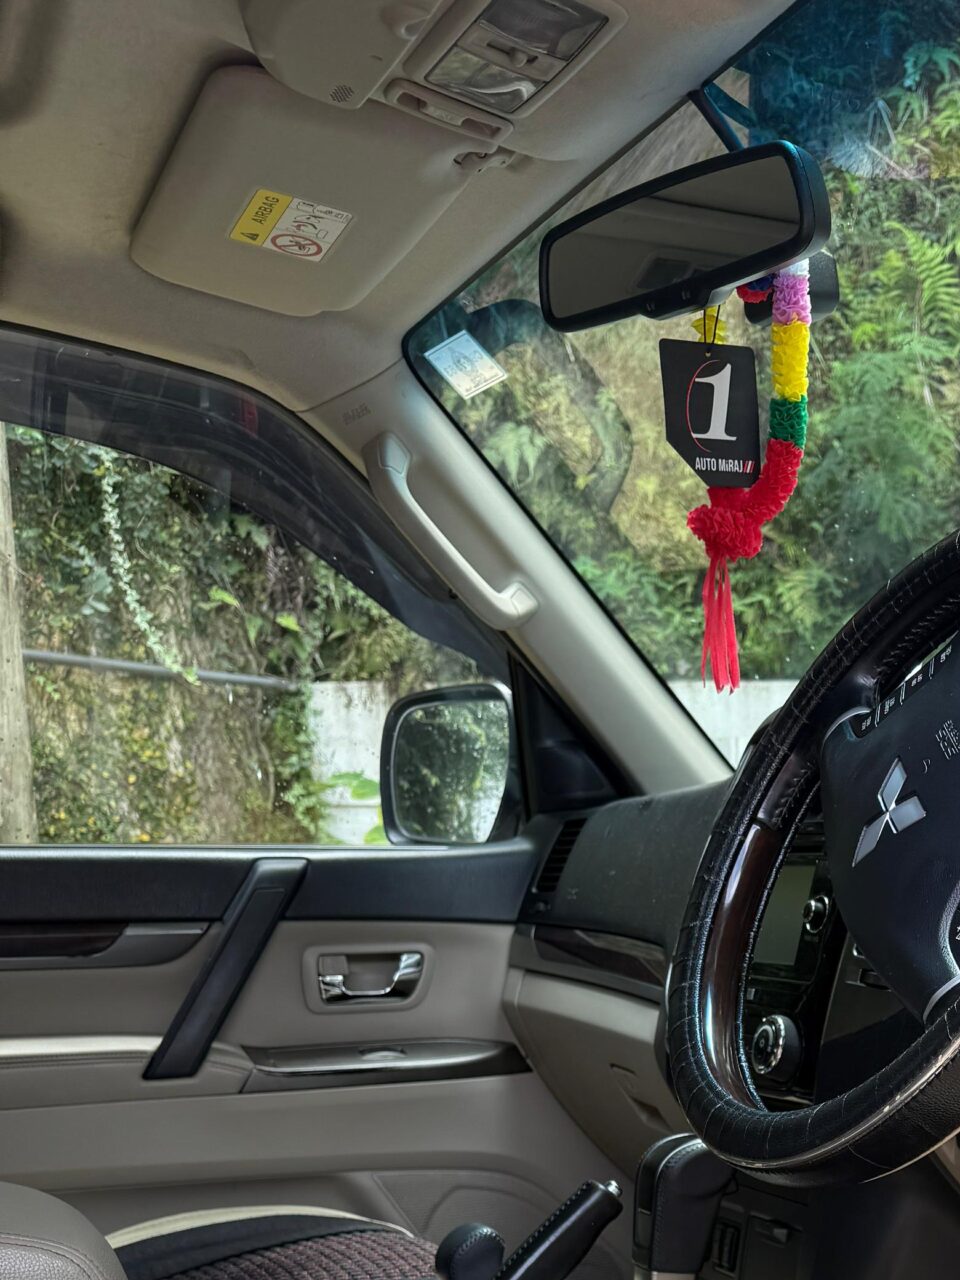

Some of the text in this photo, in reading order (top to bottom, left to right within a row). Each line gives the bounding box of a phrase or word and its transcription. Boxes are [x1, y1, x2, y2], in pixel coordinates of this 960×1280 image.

[252, 196, 279, 225] AIRBAG
[692, 363, 737, 441] 1
[695, 457, 717, 472] AUTO
